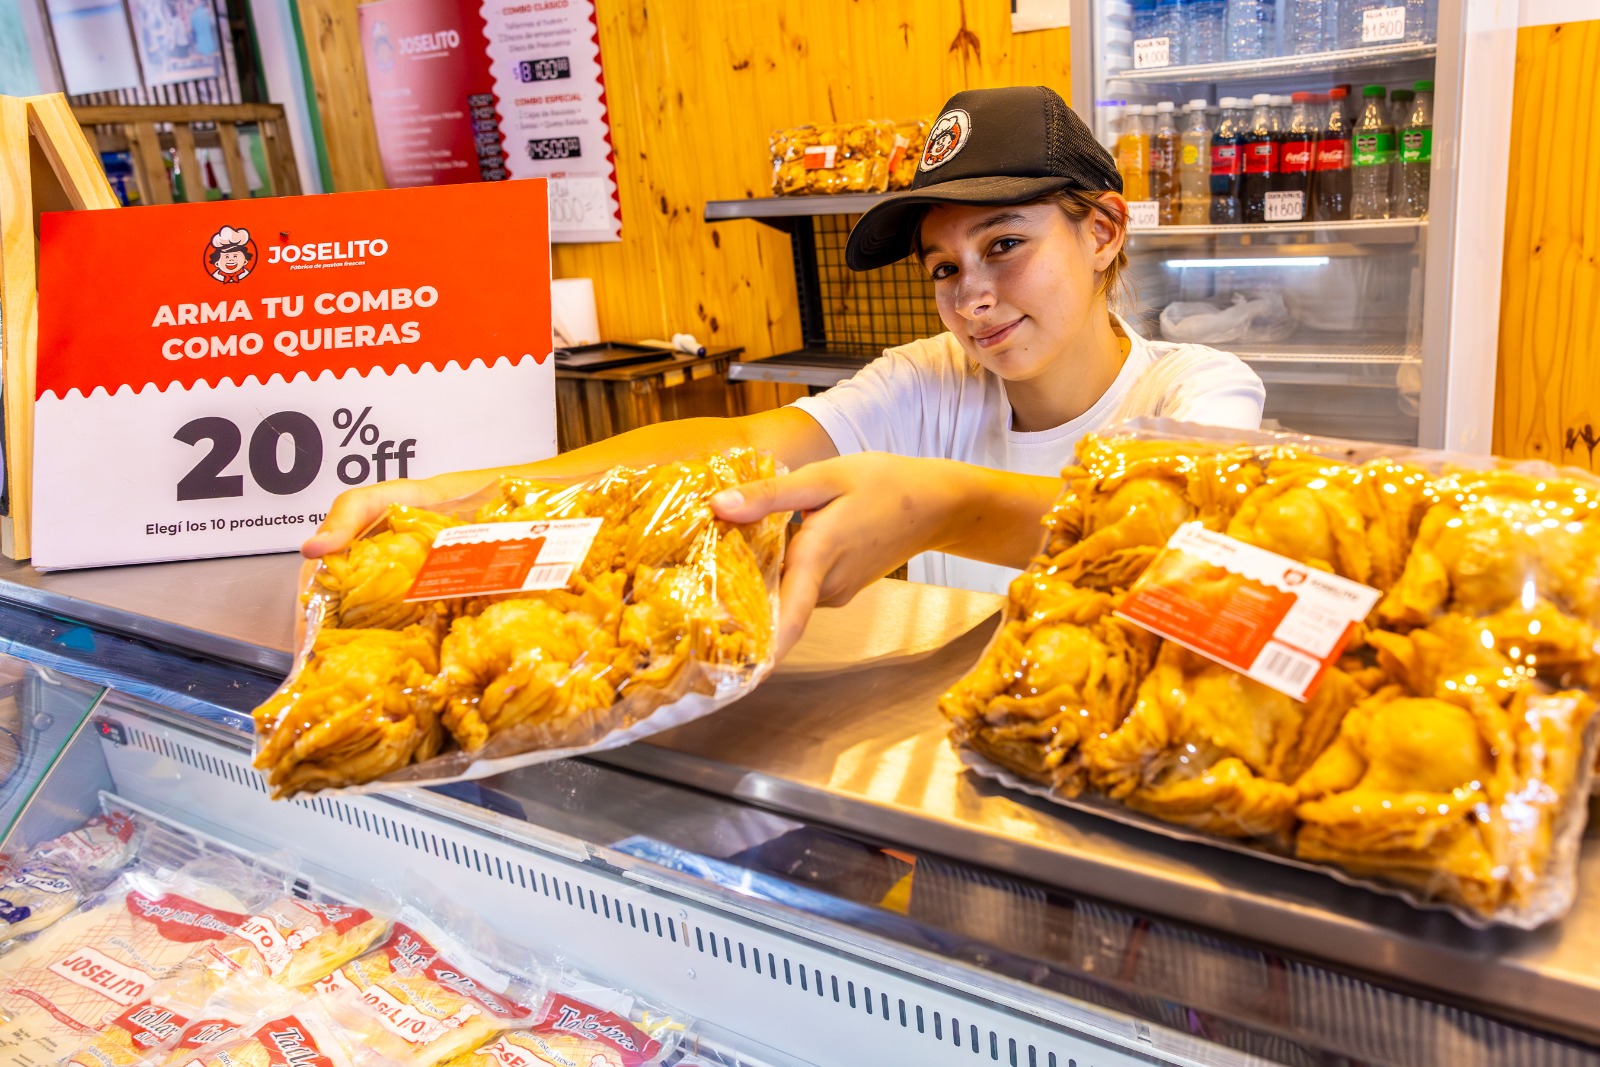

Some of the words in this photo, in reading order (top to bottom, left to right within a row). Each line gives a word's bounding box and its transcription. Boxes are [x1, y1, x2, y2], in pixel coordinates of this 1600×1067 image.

[502, 4, 532, 16] COMBO
[399, 29, 460, 54] JOSELITO
[514, 95, 543, 106] COMBO
[268, 238, 388, 264] JOSELITO
[322, 262, 343, 270] pastas
[344, 260, 366, 268] frescas
[152, 299, 253, 328] ARMA
[261, 295, 304, 319] TU
[313, 285, 439, 315] COMBO
[161, 332, 264, 361] COMO
[273, 321, 421, 357] QUIERAS
[173, 410, 324, 501] 20
[336, 438, 417, 486] off
[145, 519, 182, 536] Elegí
[186, 519, 207, 533] los
[210, 518, 226, 531] 10
[230, 511, 304, 532] productos
[308, 512, 328, 526] qu
[62, 956, 145, 997] JOSELITO
[130, 1005, 179, 1038] Tallar
